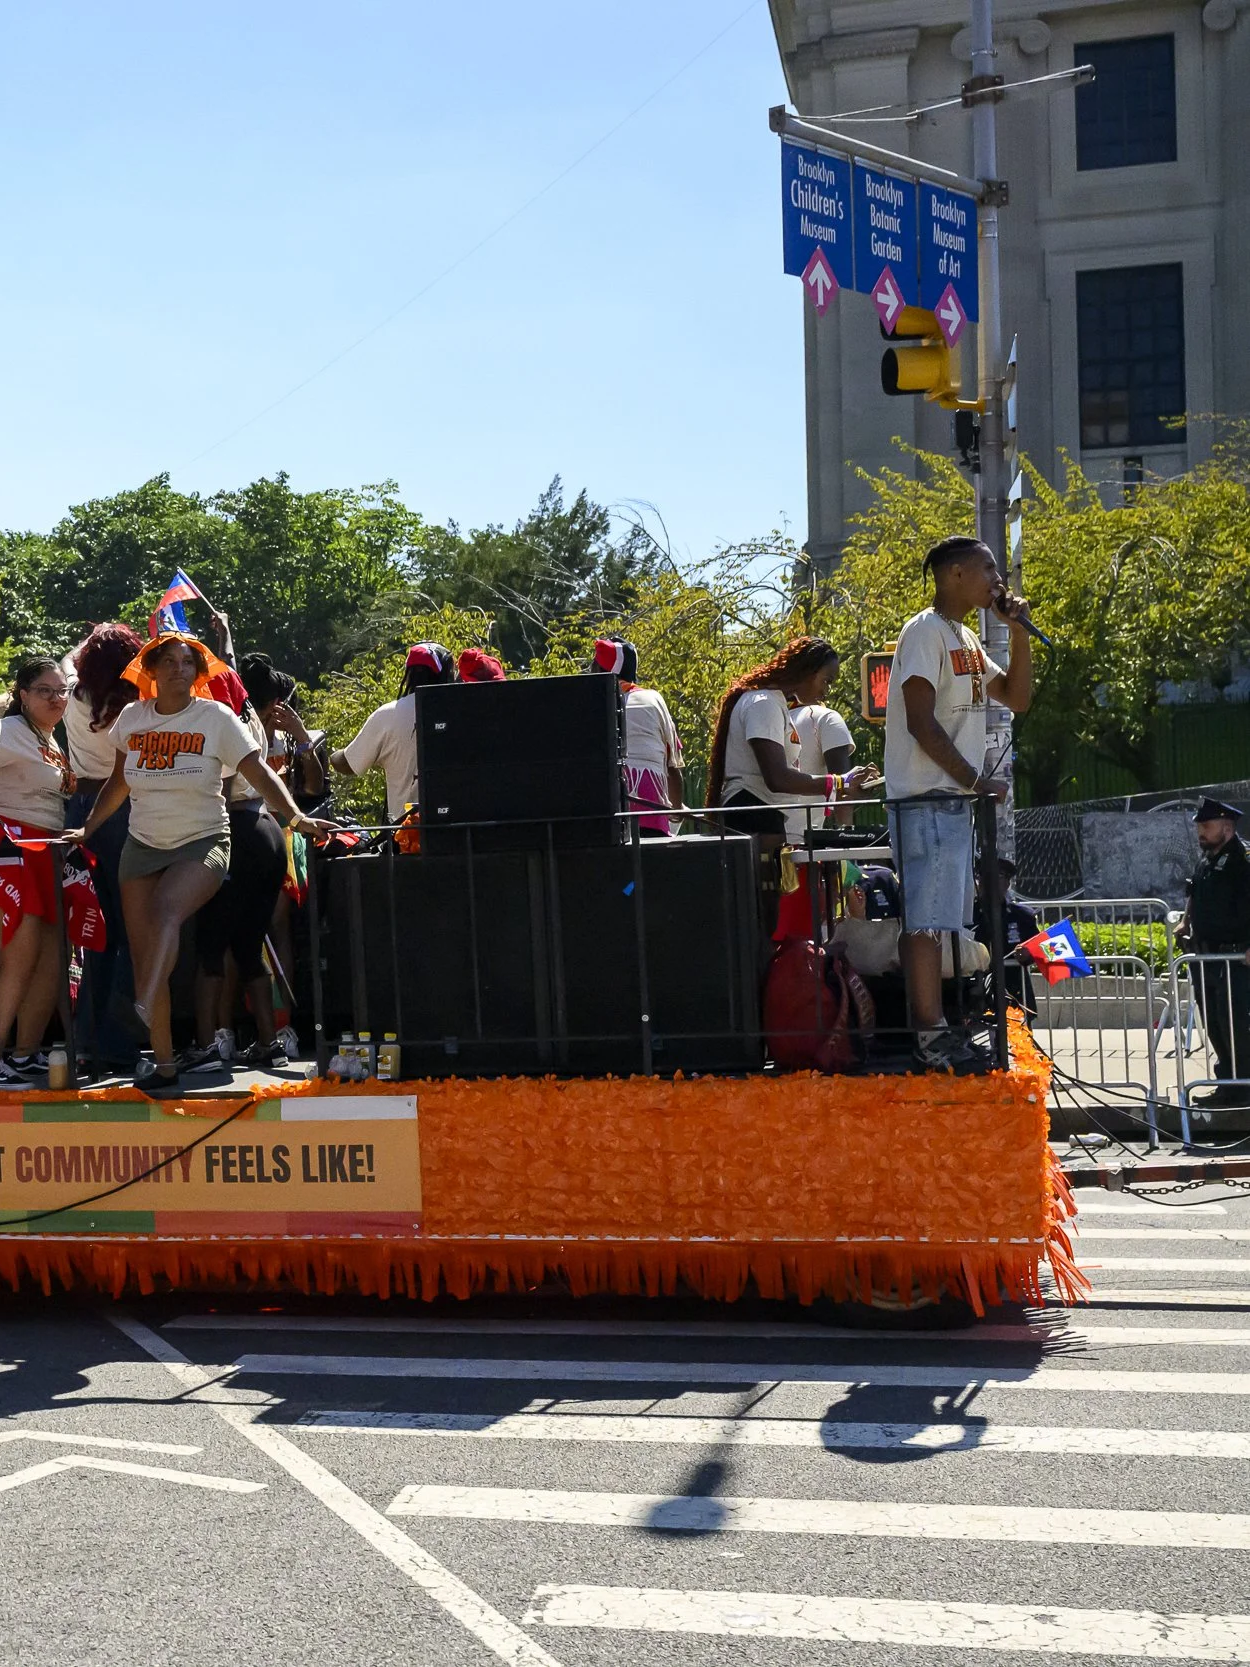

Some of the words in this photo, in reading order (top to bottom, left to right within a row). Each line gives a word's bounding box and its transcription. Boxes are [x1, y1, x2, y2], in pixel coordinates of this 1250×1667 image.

[798, 155, 835, 189] Brooklyn
[790, 178, 844, 220] Children's
[865, 174, 903, 210] Brooklyn
[870, 204, 901, 234] Botanic
[931, 194, 966, 230] Brooklyn
[800, 216, 836, 244] Museum
[933, 223, 966, 253] Museum
[871, 233, 902, 262] Garden
[938, 252, 948, 275] of
[948, 259, 961, 279] Art
[127, 731, 205, 755] NEIGHBOR
[137, 749, 177, 770] FEST
[15, 1144, 192, 1184] COMMUNITY
[205, 1144, 291, 1183] FEELS
[302, 1144, 375, 1183] LIKE!
